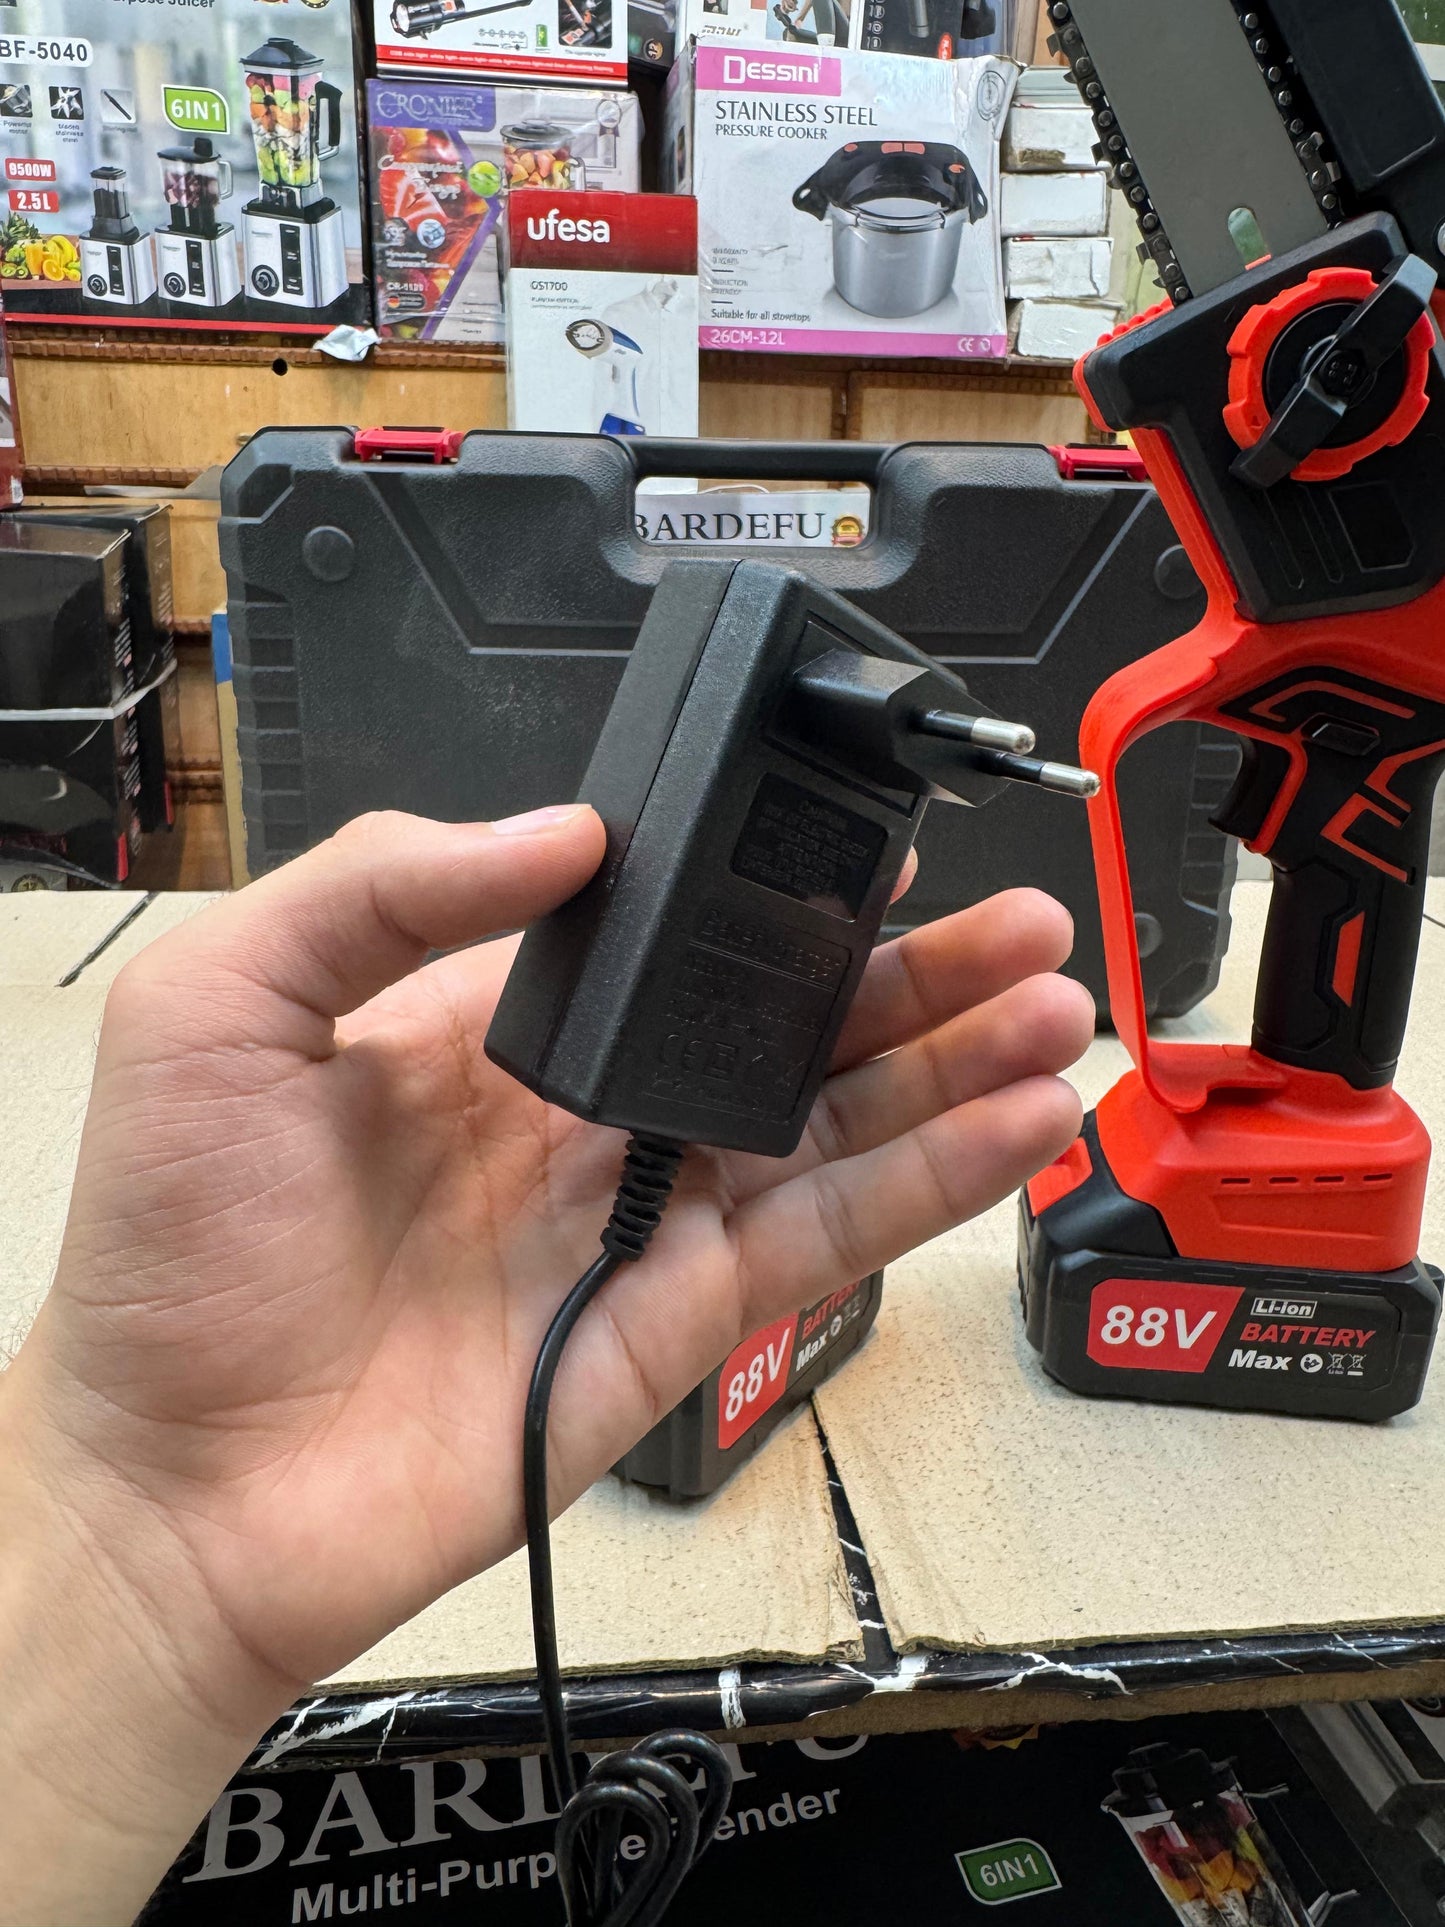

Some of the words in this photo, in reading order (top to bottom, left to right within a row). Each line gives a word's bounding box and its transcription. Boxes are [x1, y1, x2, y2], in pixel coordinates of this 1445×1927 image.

[0, 40, 88, 62] BF-5040
[171, 99, 221, 121] 6IN1
[715, 100, 817, 124] STAINLESS
[824, 105, 878, 126] STEEL
[715, 124, 773, 138] PRESSURE
[778, 126, 827, 140] COOKER
[17, 192, 51, 210] 2.5L
[527, 208, 610, 243] ufesa
[711, 309, 744, 320] Suitable
[746, 310, 758, 320] for
[760, 311, 770, 320] all
[710, 329, 785, 346] 26CM-12L
[1101, 1305, 1217, 1349] 88V
[1239, 1323, 1376, 1348] BATTERY
[796, 1330, 828, 1371] Max
[1228, 1349, 1293, 1371] Max
[725, 1327, 790, 1422] 88V
[292, 1834, 646, 1924] Multi-Purpe
[980, 1853, 1039, 1887] 6IN1
